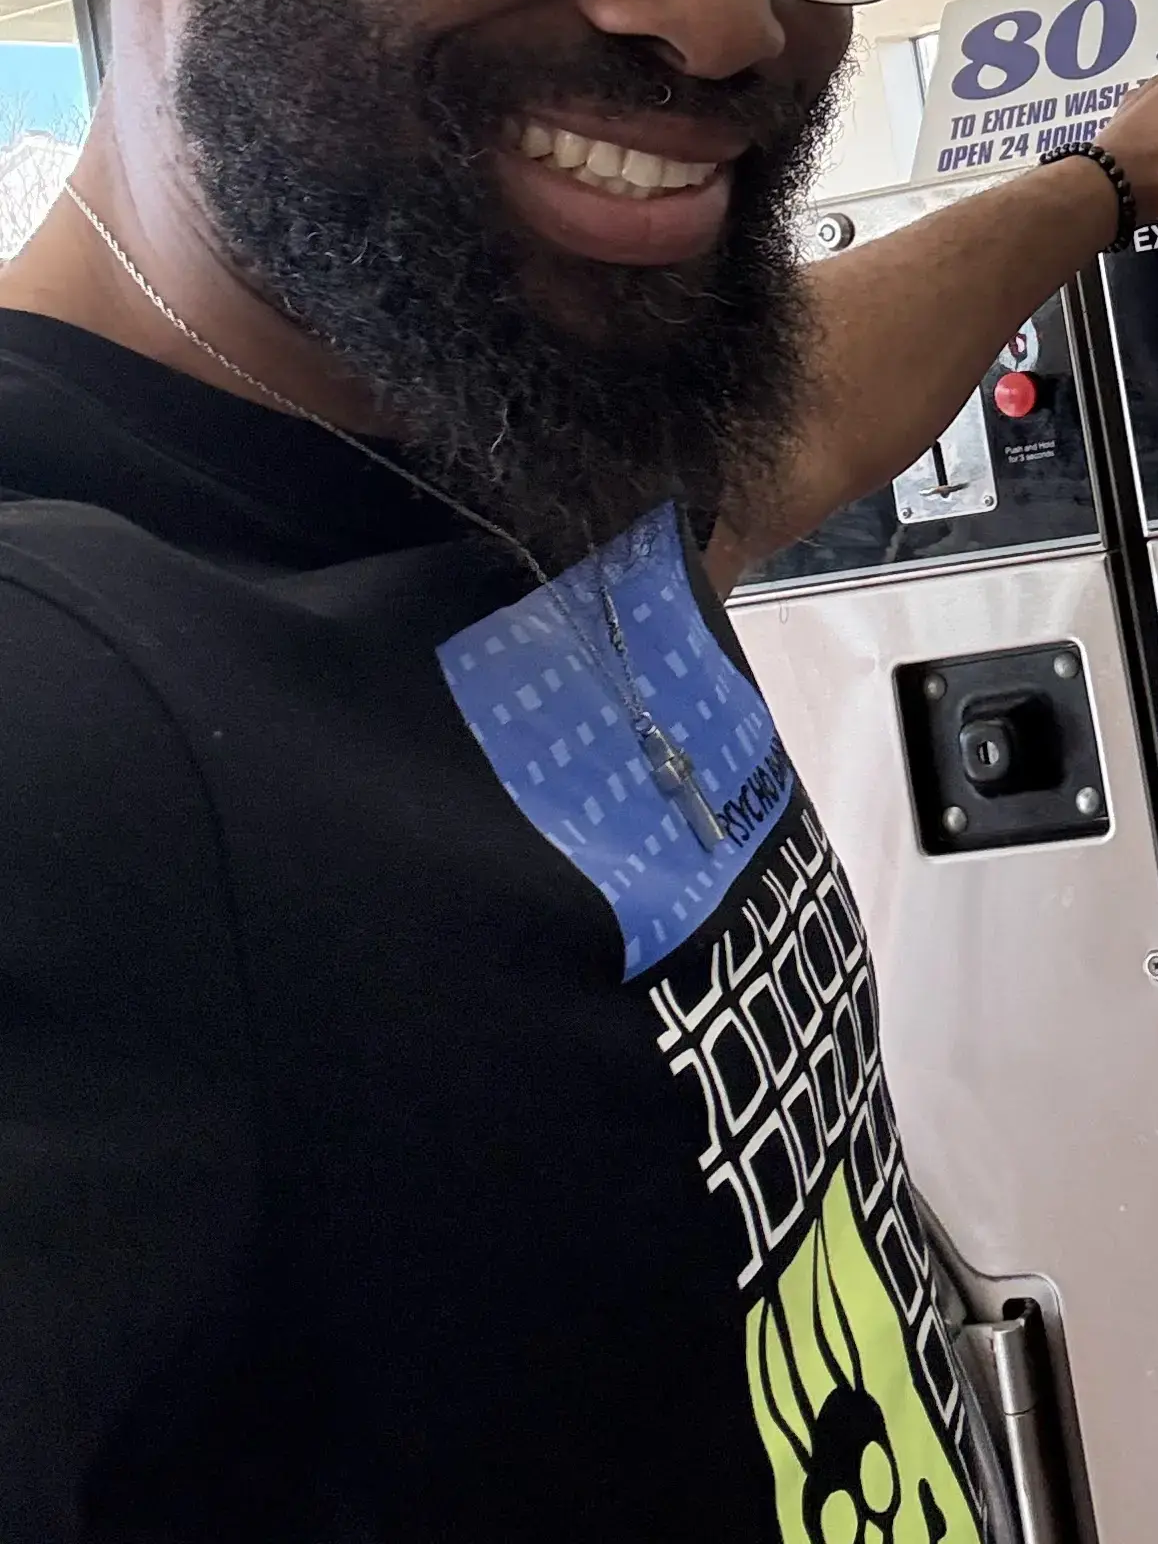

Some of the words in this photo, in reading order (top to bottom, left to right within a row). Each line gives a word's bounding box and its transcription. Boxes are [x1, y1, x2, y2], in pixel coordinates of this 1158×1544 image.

[950, 113, 975, 140] TO
[980, 97, 1058, 135] EXTEND
[1065, 82, 1129, 118] WASH
[936, 139, 994, 172] OPEN
[1000, 132, 1029, 161] 24
